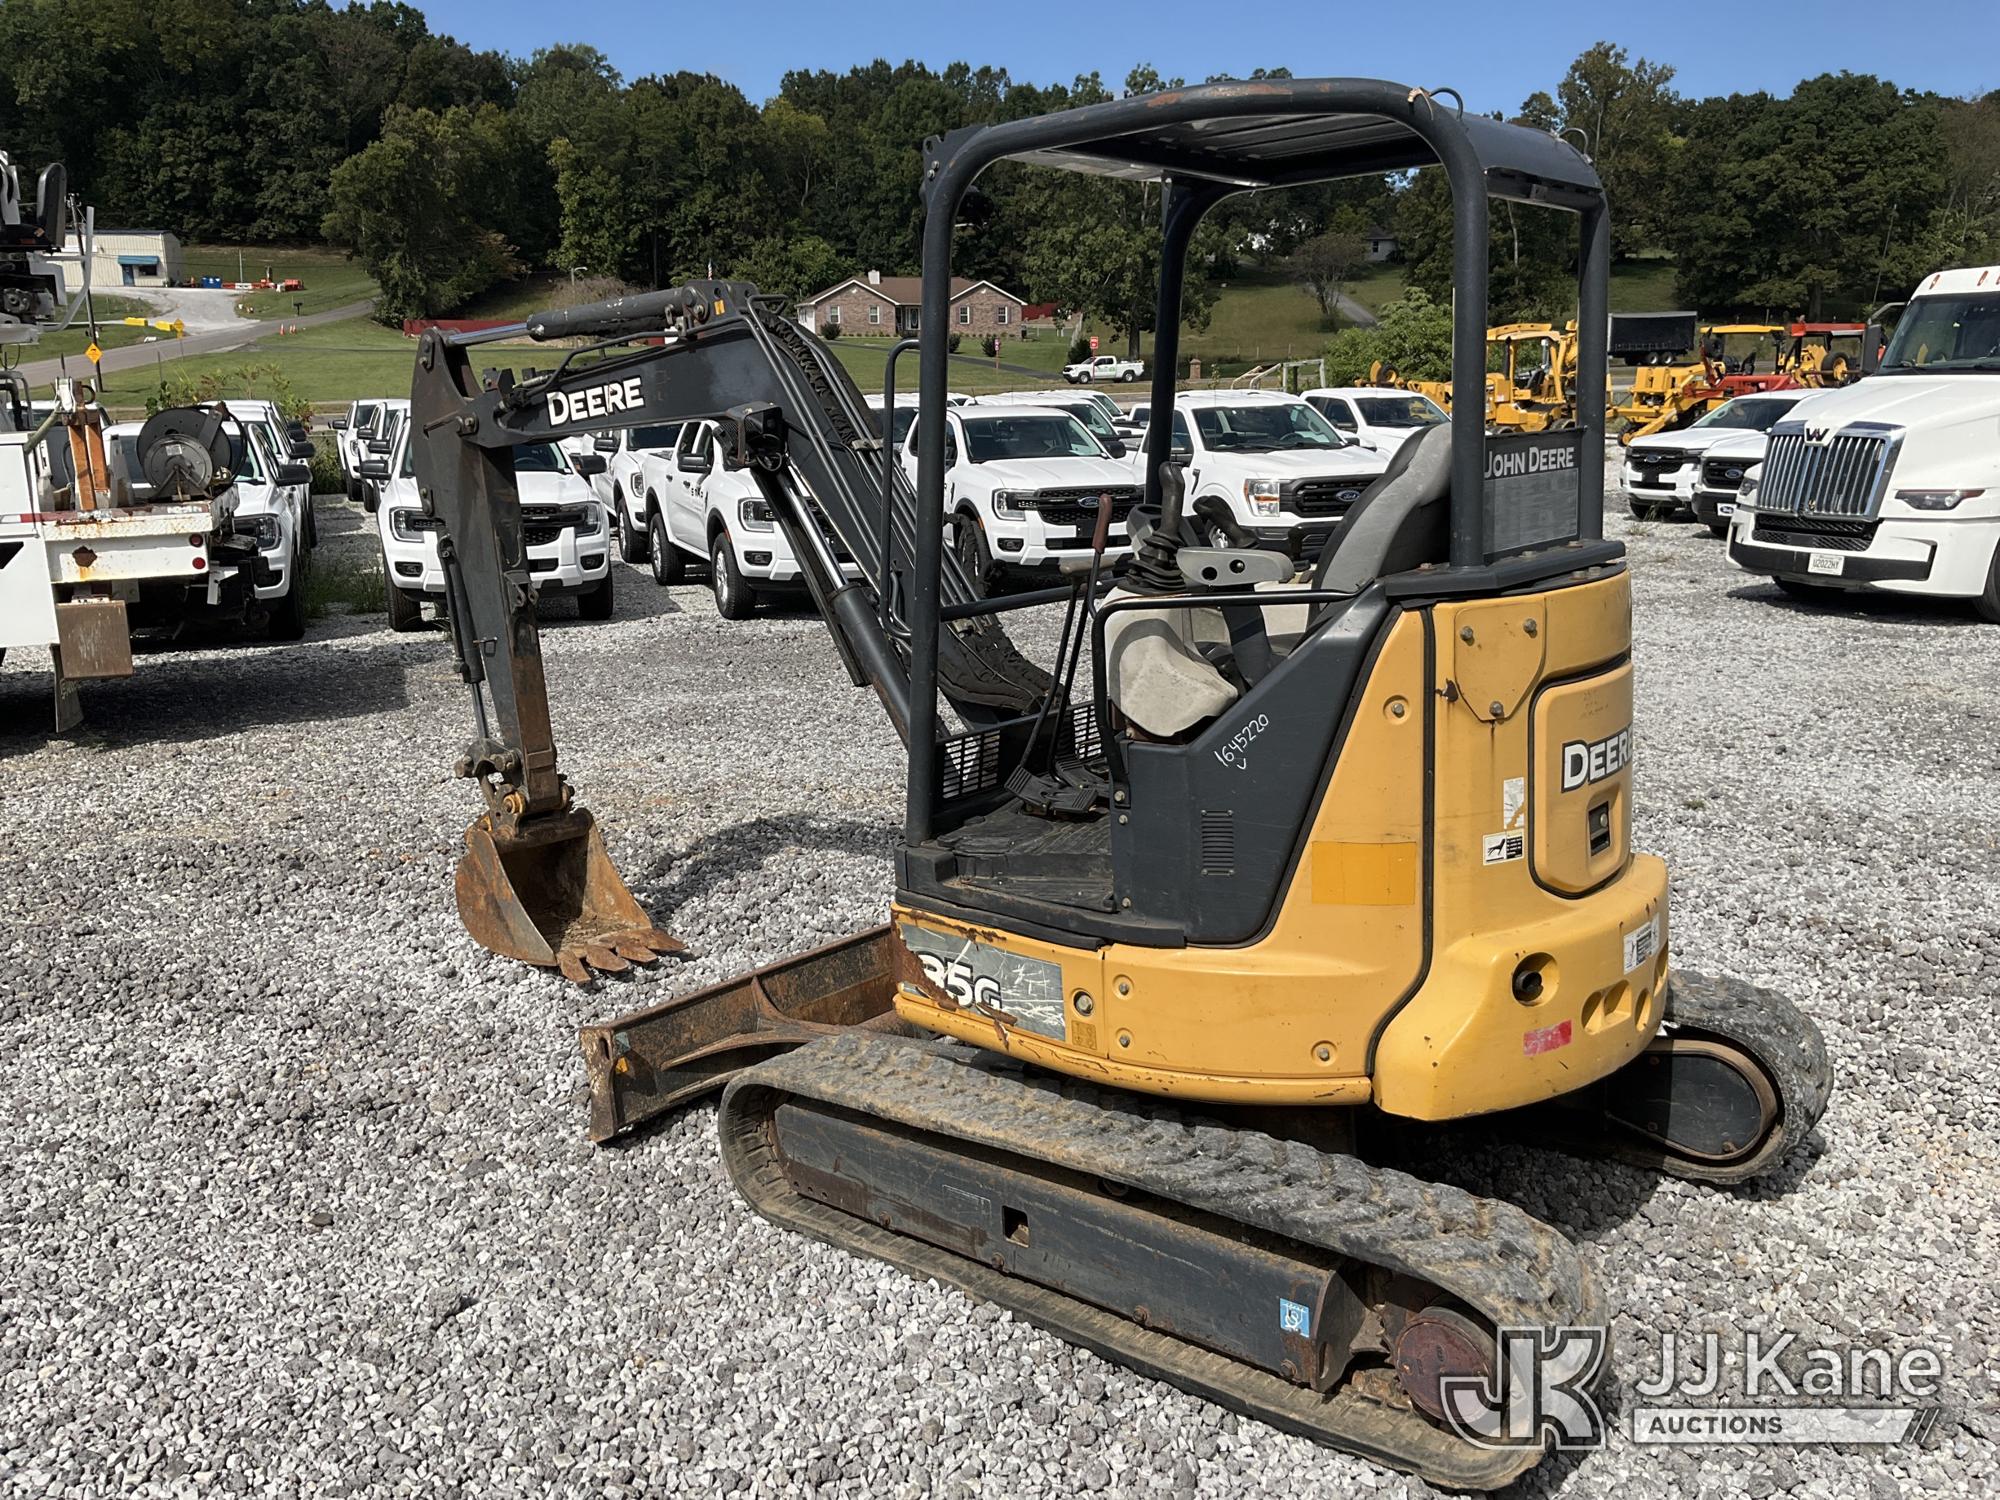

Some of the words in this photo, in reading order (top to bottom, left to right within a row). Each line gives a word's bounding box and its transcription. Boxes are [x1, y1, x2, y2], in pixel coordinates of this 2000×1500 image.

[545, 377, 645, 426] DEERE
[1484, 450, 1526, 479] JOHN
[1528, 446, 1575, 473] DEERE
[1213, 713, 1270, 768] 1645220
